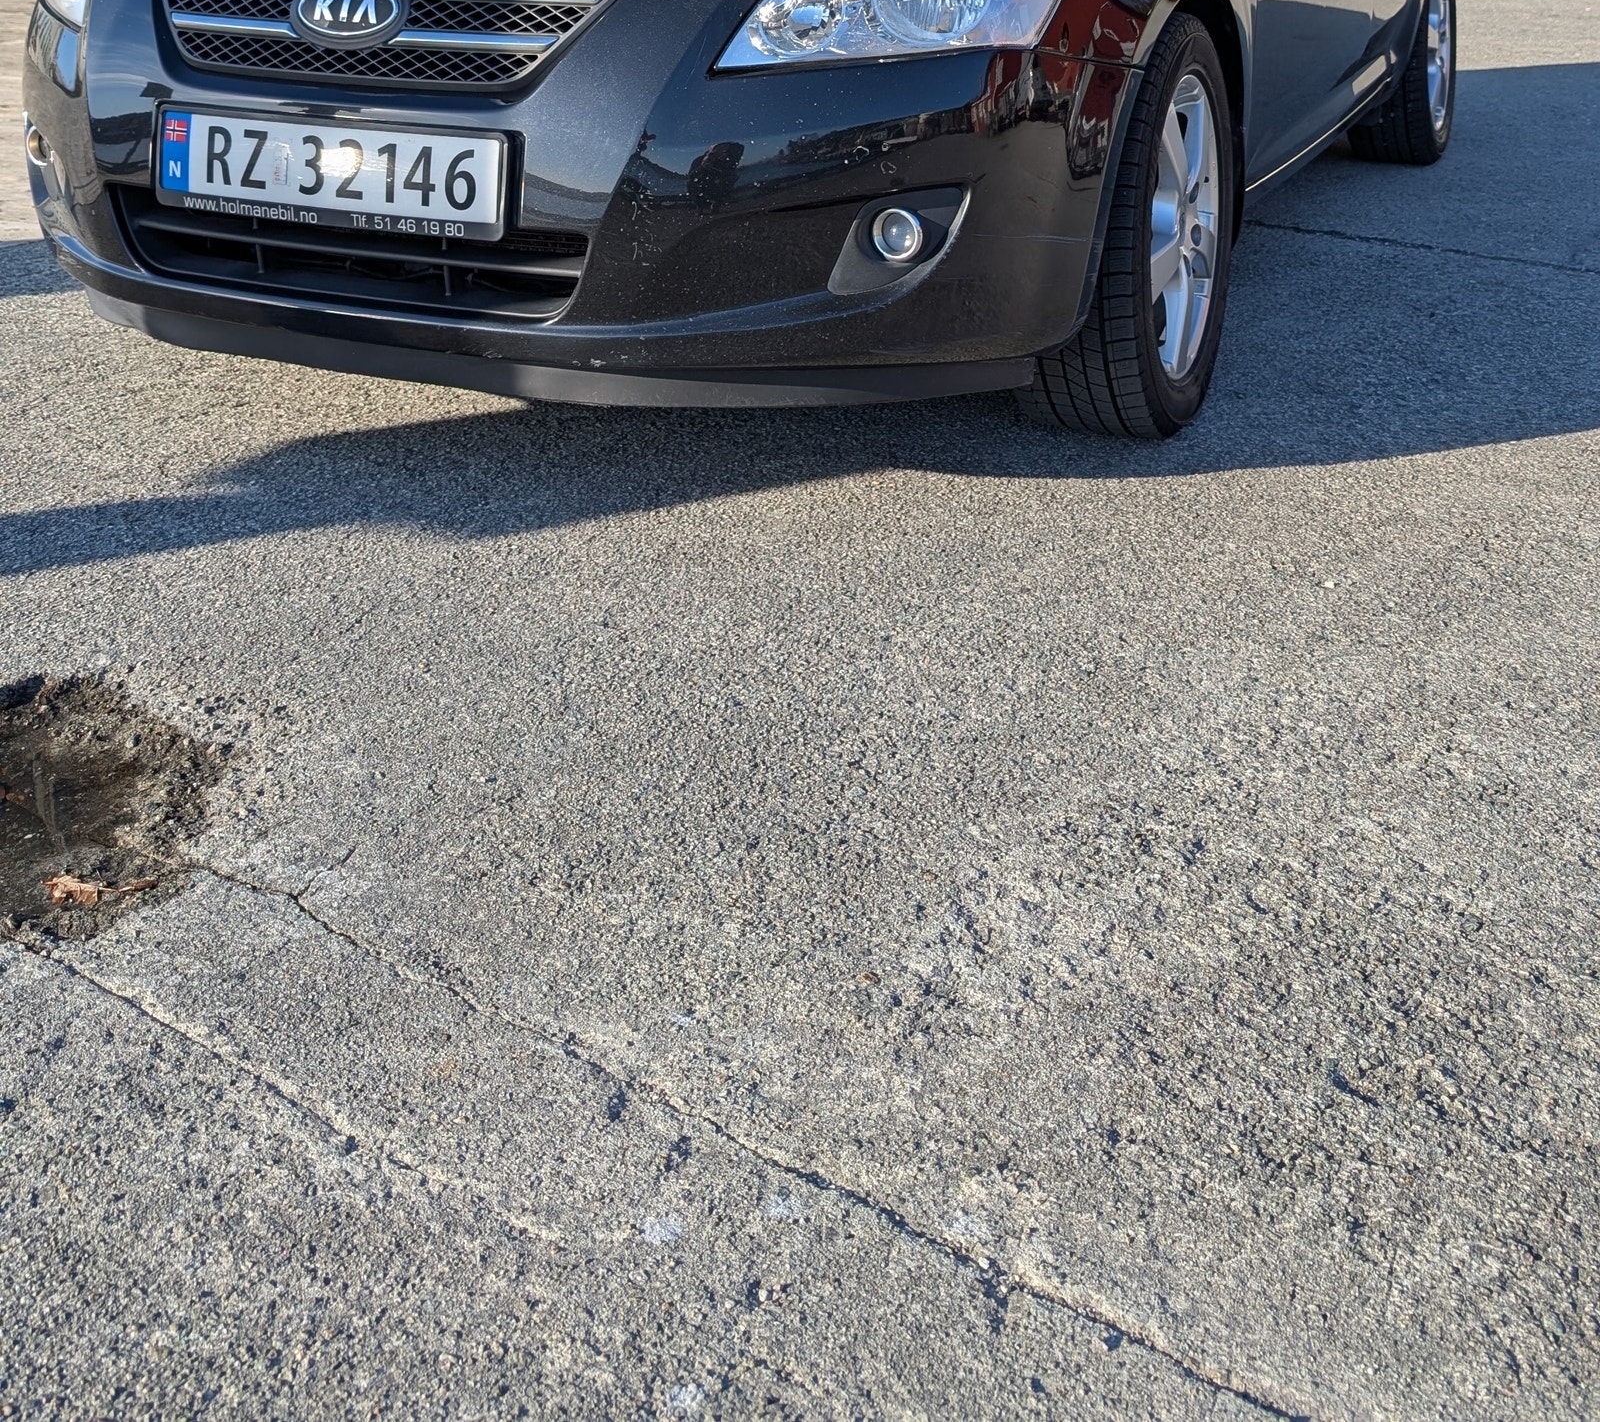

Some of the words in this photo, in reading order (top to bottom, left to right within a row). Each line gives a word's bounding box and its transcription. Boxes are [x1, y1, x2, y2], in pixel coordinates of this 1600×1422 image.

[168, 159, 182, 178] N
[206, 125, 268, 190] RZ
[298, 134, 477, 211] 32146
[183, 195, 318, 224] www.holmanebil.no
[374, 216, 391, 230] 51
[397, 218, 416, 233] 46
[422, 220, 440, 235] 19
[444, 222, 465, 237] 80
